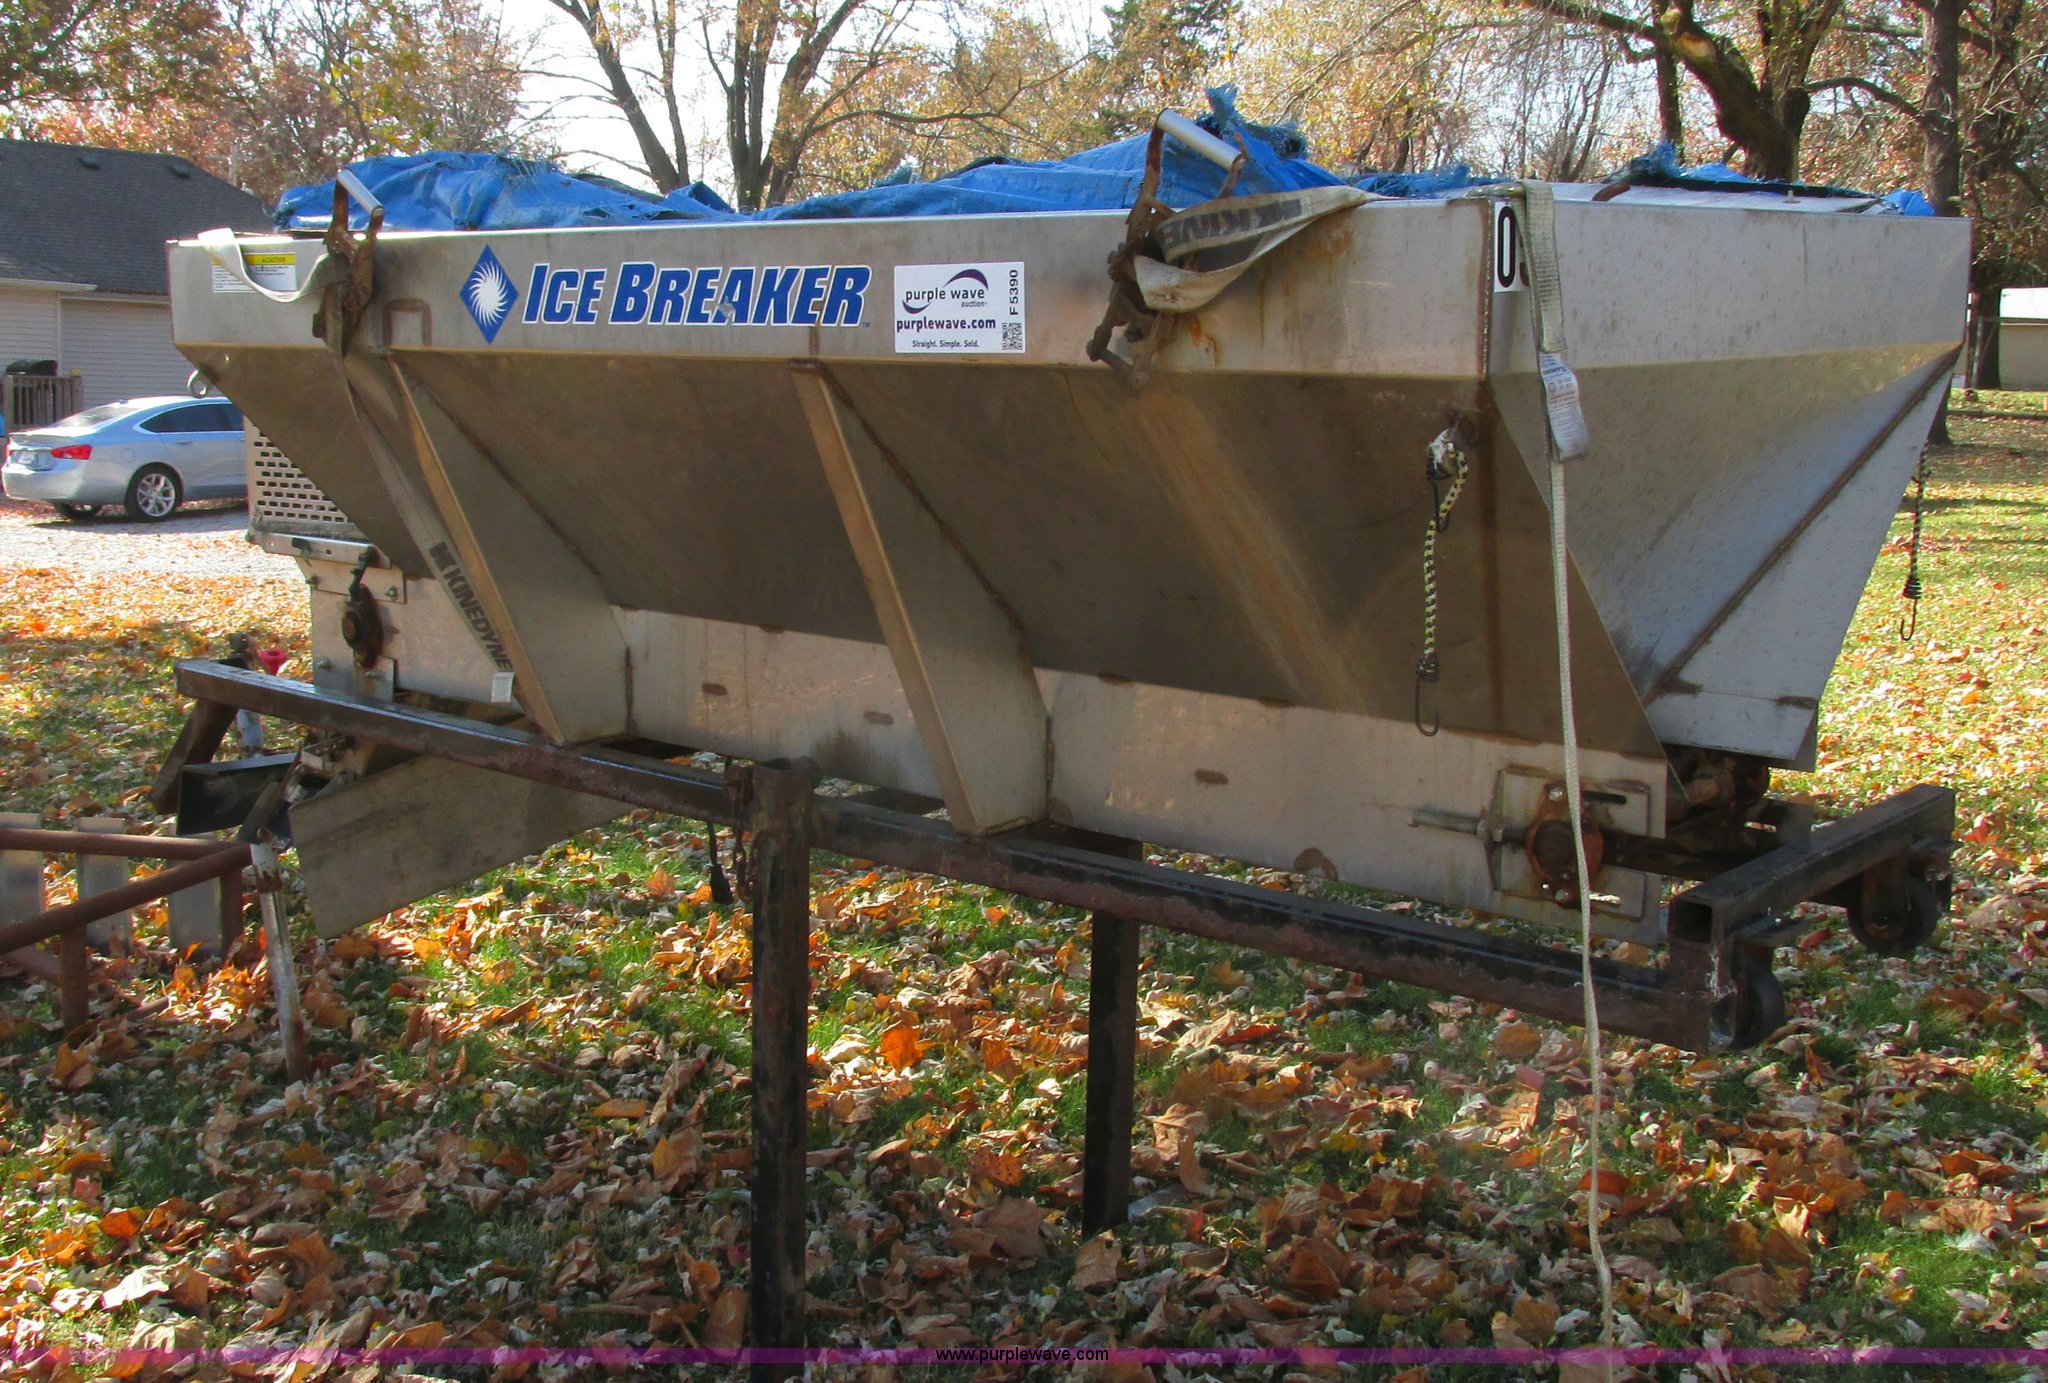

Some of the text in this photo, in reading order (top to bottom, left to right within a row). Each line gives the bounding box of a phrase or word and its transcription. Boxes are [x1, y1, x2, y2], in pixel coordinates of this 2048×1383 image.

[522, 263, 607, 324] ICE
[608, 261, 872, 327] BREAKER
[905, 287, 985, 303] purple wave
[896, 316, 996, 333] purplewave.com
[912, 340, 980, 349] Straight. Simple. Sold.
[443, 567, 513, 670] KINEDYNE
